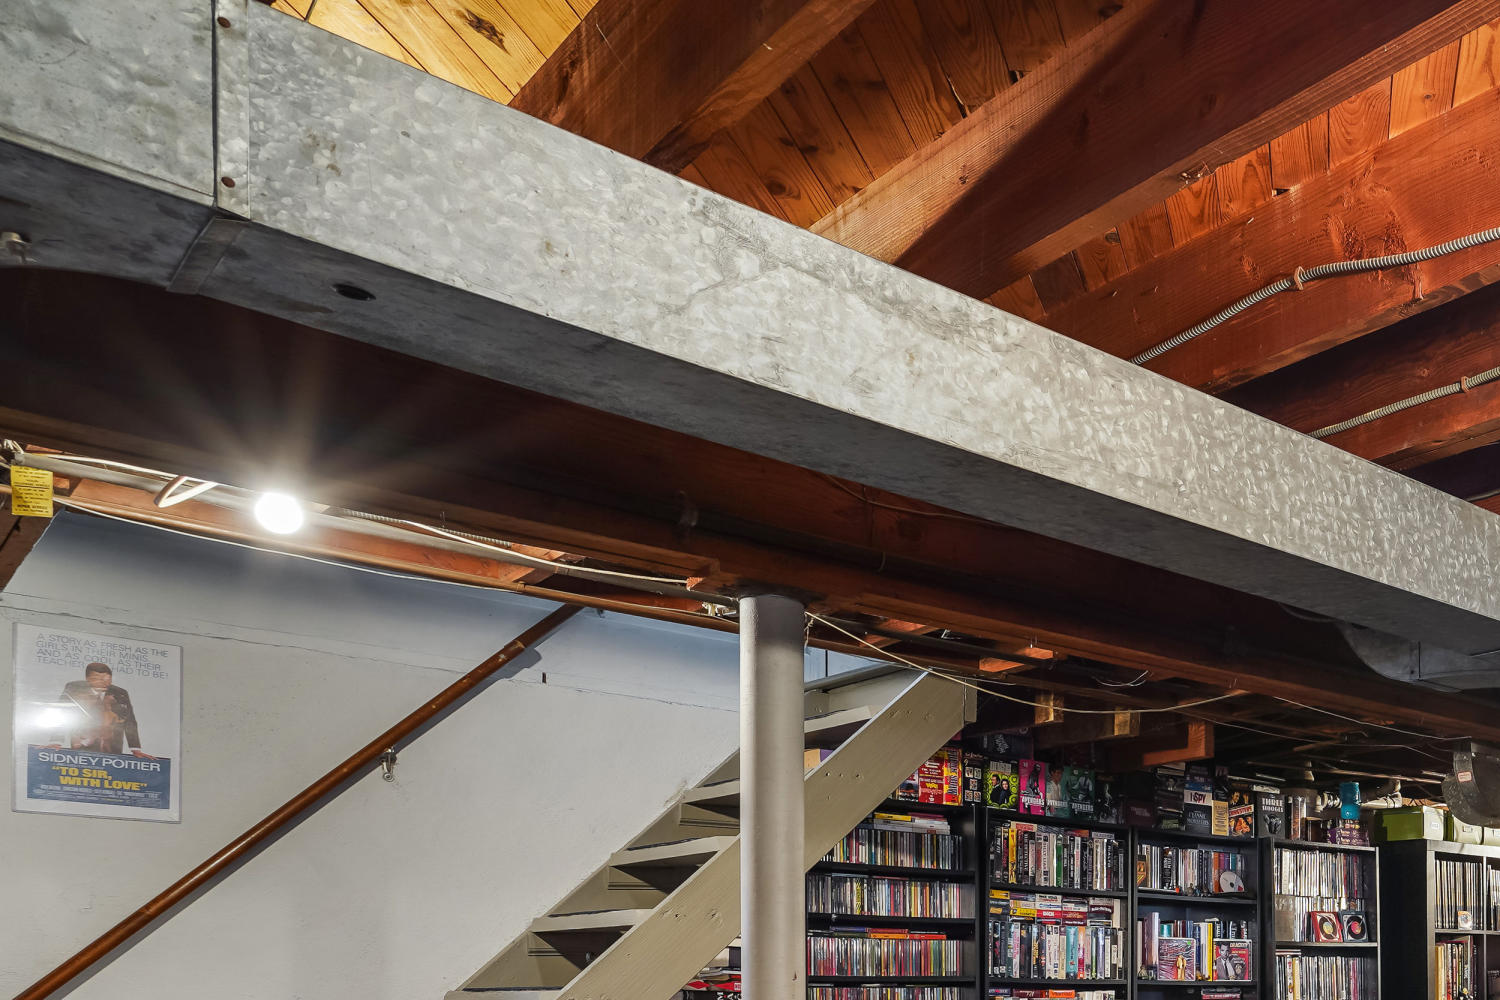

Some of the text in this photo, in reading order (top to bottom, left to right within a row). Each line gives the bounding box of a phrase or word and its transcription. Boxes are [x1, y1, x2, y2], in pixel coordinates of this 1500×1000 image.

[36, 640, 69, 652] GIRLS
[71, 645, 83, 653] IN
[86, 647, 117, 657] THEIR
[37, 633, 169, 658] A STORY AS FRESH AS THE
[36, 648, 161, 671] AND AS COOL AS THEIR
[111, 666, 134, 676] HAD
[136, 669, 150, 677] TO
[38, 752, 99, 766] SIDNEY
[102, 758, 161, 772] POITIER
[59, 775, 101, 787] WITH
[82, 767, 113, 780] SIR,
[1262, 798, 1283, 807] THREE
